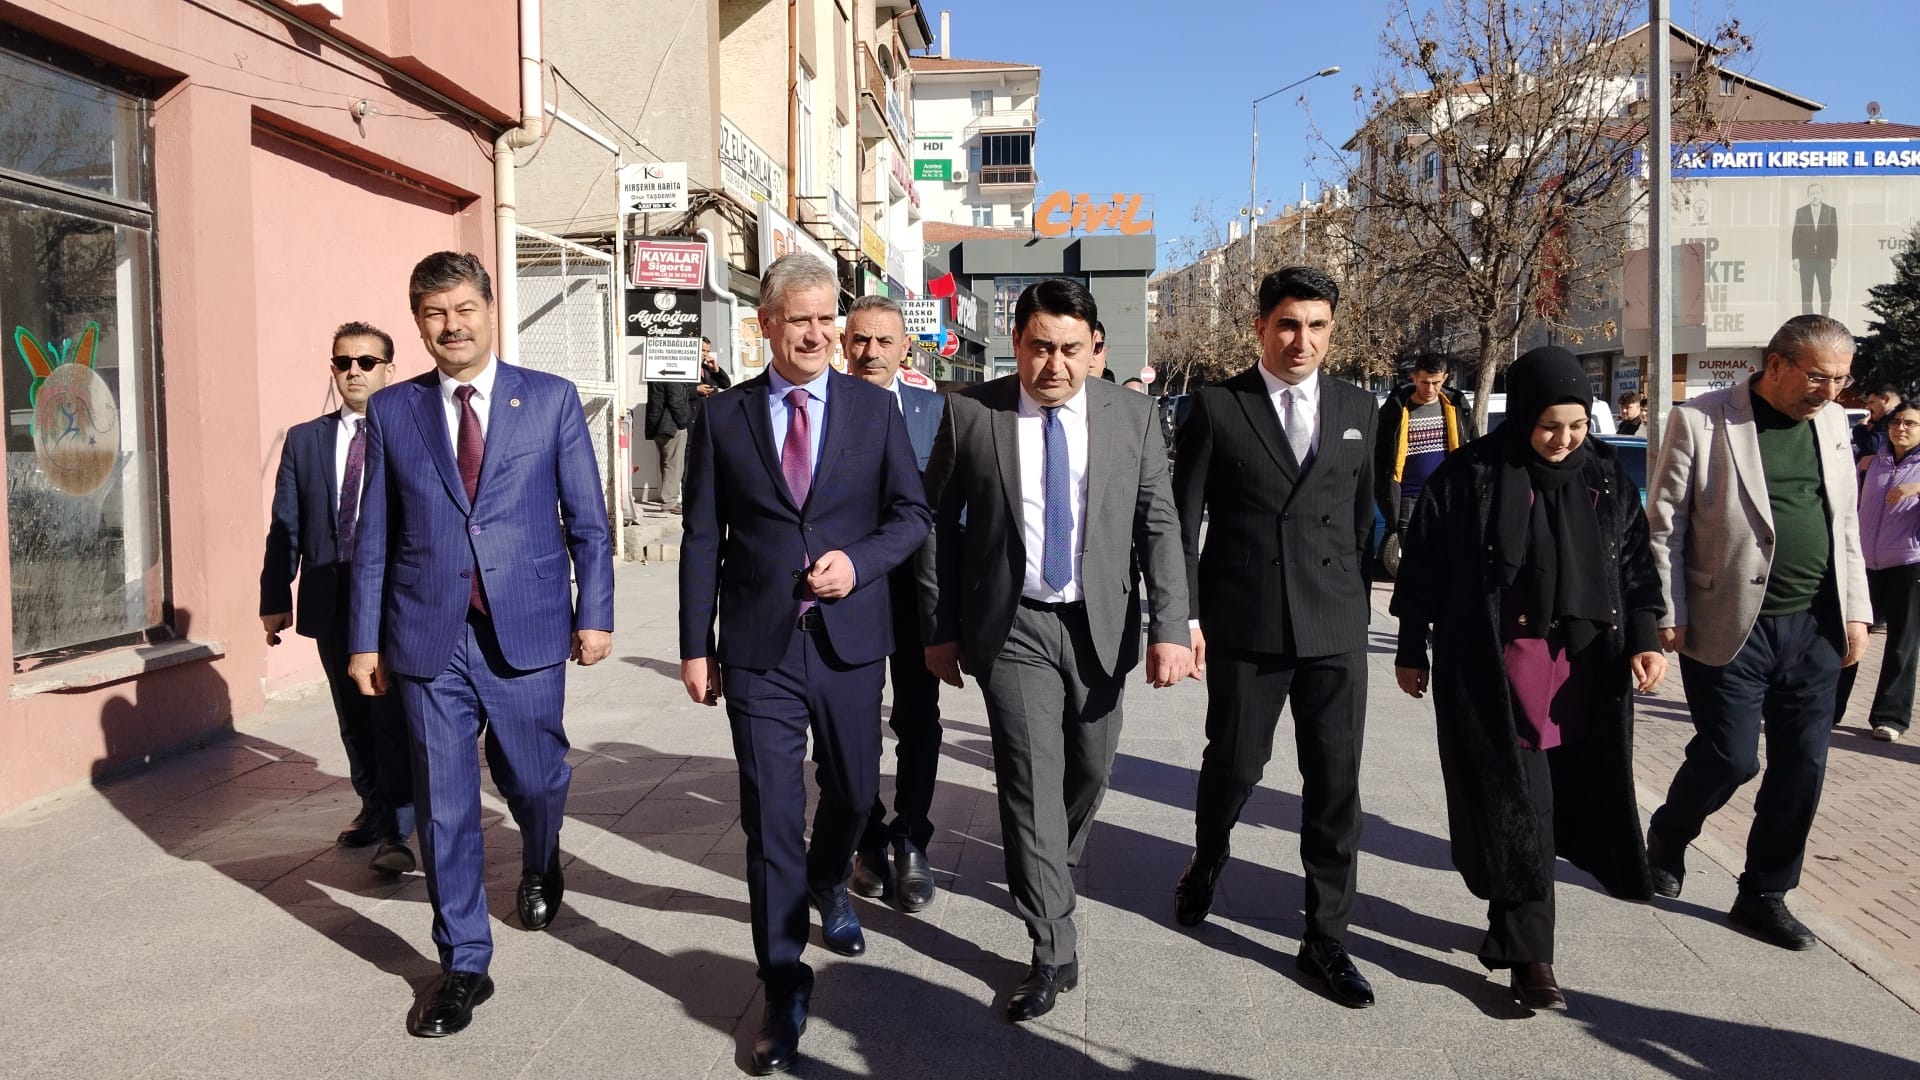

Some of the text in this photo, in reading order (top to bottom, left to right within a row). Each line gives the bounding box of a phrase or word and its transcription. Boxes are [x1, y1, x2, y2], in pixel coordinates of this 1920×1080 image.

[923, 142, 944, 151] HDI
[1677, 153, 1706, 169] AK
[1712, 151, 1763, 168] PARTİ
[1768, 151, 1849, 169] KIRŞEHİR
[1854, 150, 1869, 167] İL
[749, 147, 772, 190] EMLAK
[624, 180, 681, 193] KIRŞEHİR HARİTA
[641, 250, 700, 264] KAYALAR
[647, 262, 693, 273] Sigorta
[628, 310, 699, 328] Aydoğan
[1698, 360, 1748, 369] DURMAK
[1711, 371, 1736, 380] YOK
